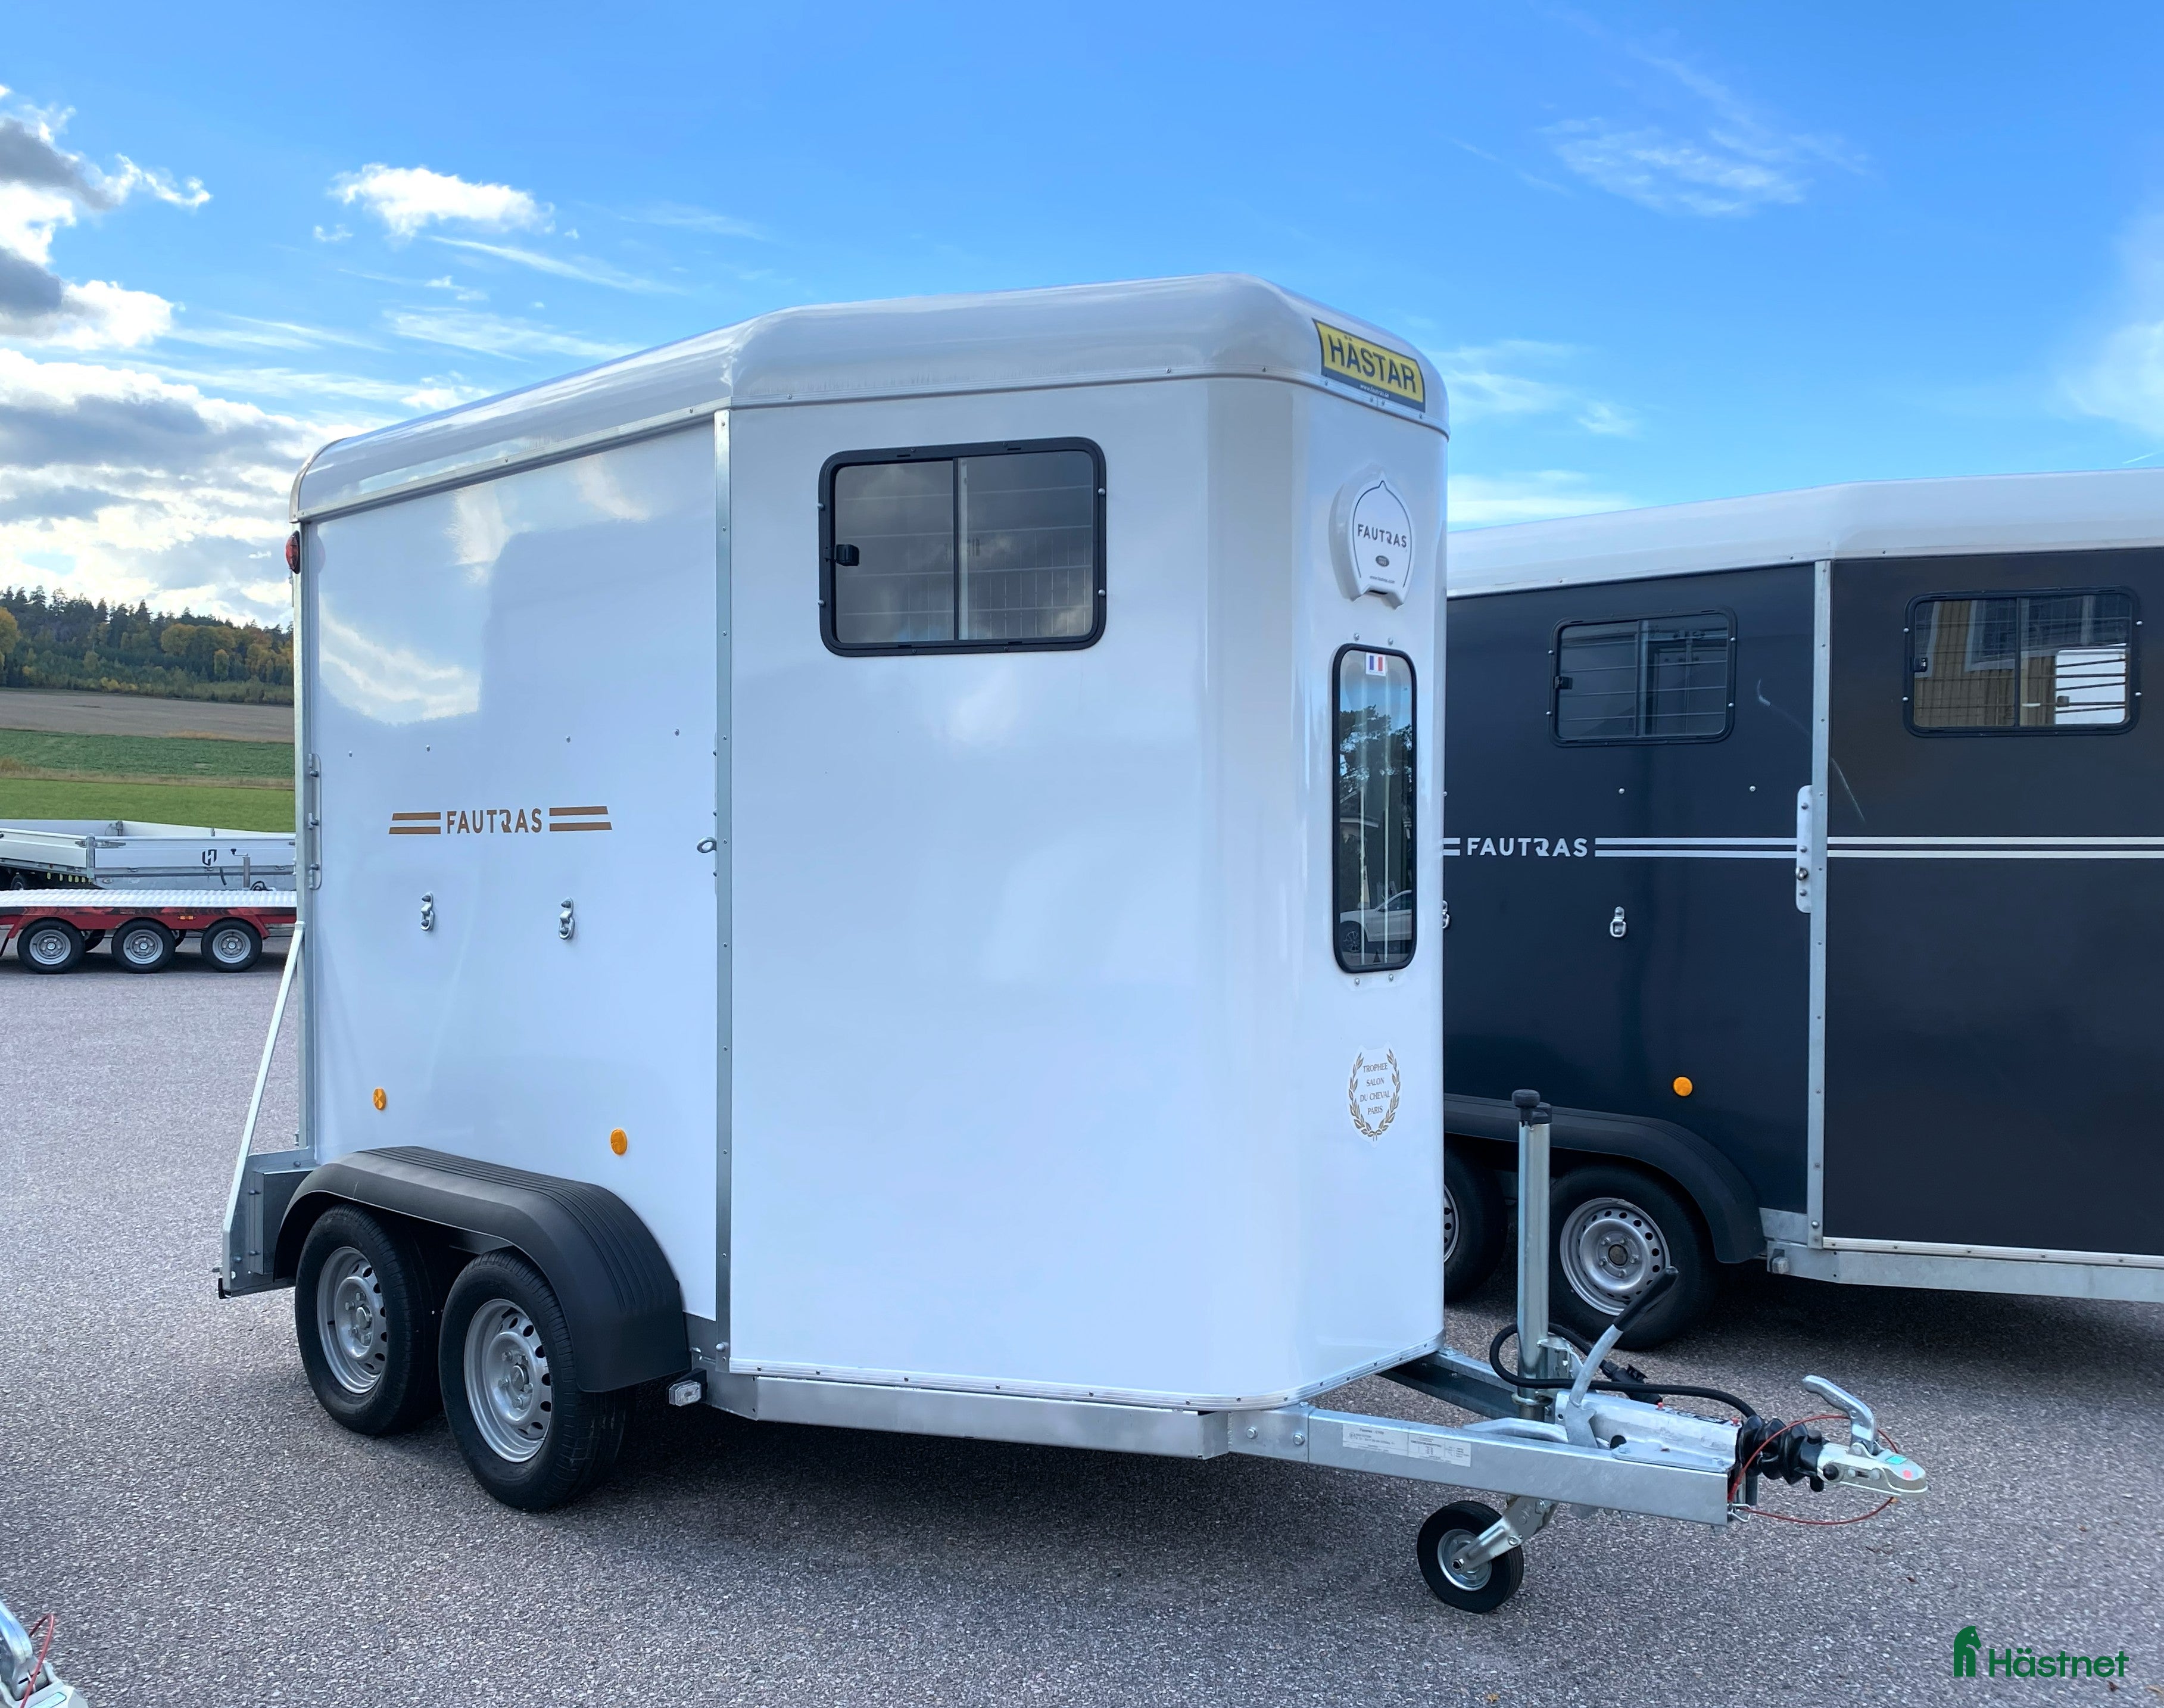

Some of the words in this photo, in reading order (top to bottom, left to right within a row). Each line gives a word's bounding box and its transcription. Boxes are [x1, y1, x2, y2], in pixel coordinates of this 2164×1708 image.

[1328, 334, 1417, 394] HÄSTAR
[1357, 523, 1407, 548] FAUTRAS
[447, 808, 542, 834] FAUTRAS
[1467, 837, 1588, 858] FAUTRAS
[1366, 1077, 1385, 1087] SALON
[1359, 1093, 1368, 1102] DU
[1369, 1090, 1390, 1101] CHEVAL
[1367, 1105, 1383, 1115] PARIS
